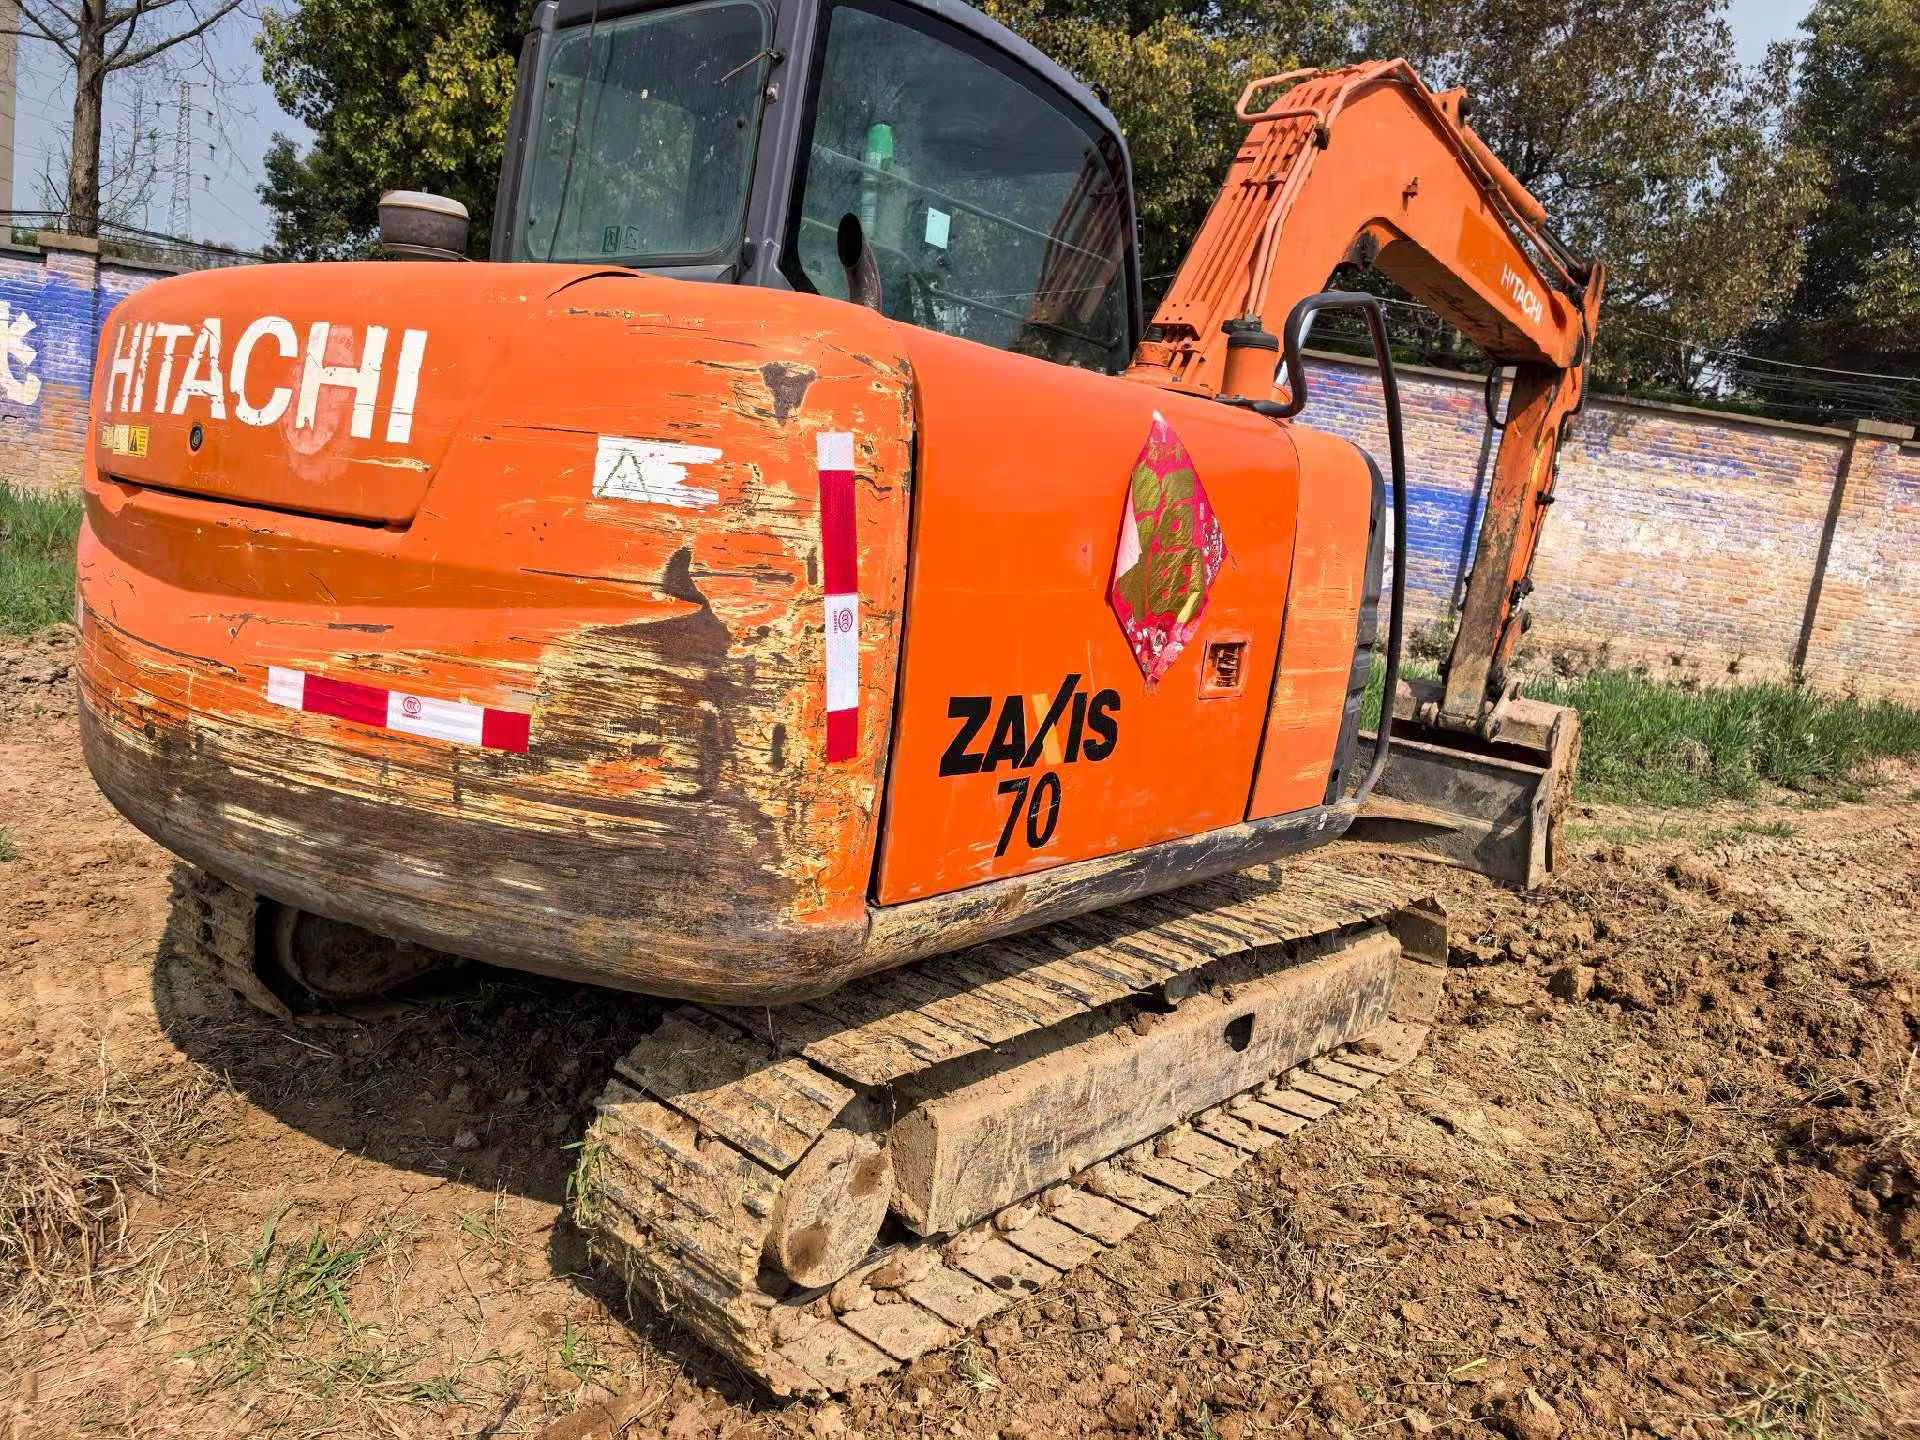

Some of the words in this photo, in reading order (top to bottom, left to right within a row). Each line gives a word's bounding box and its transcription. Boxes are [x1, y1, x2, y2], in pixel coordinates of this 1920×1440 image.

[105, 316, 427, 443] HITACHI
[939, 673, 1121, 777] ZAXIS
[993, 772, 1061, 857] 70
